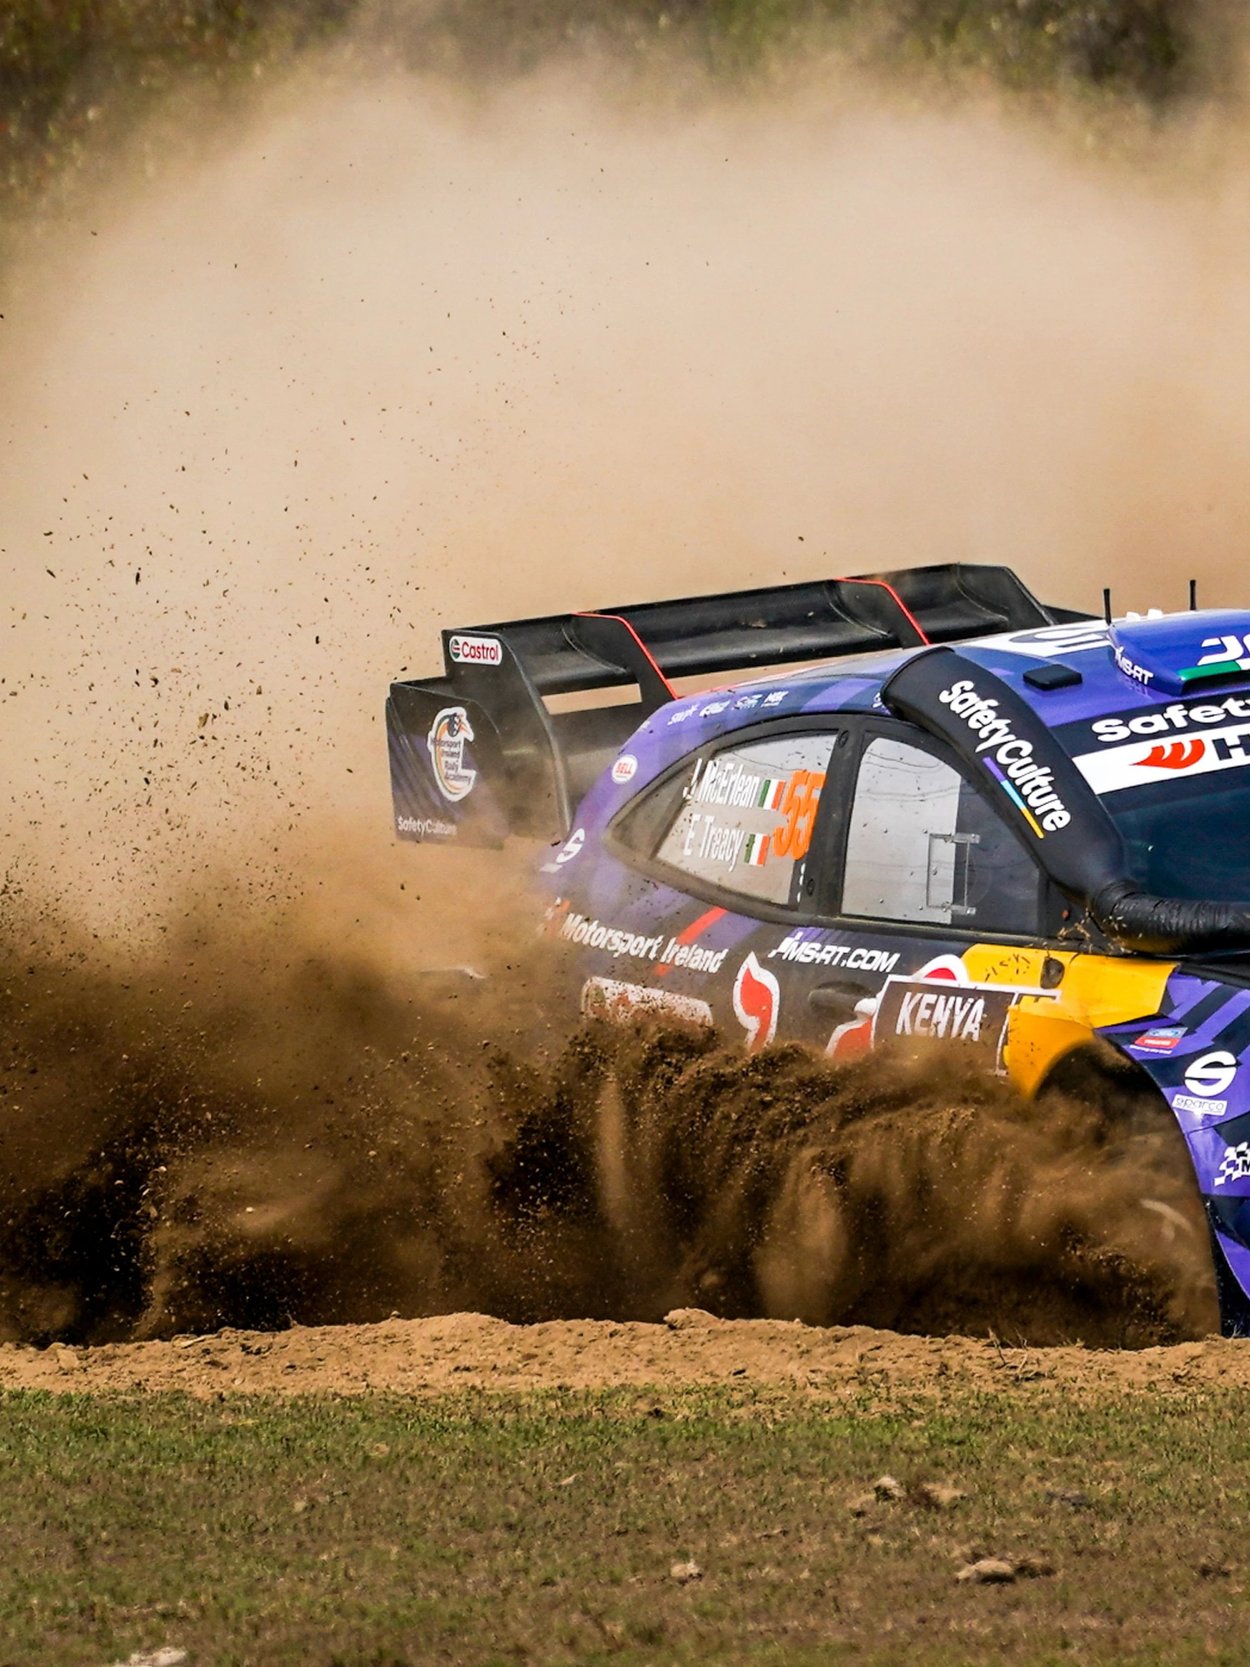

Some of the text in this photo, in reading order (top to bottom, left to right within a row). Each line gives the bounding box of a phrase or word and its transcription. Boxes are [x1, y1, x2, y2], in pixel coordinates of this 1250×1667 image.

[461, 641, 499, 661] Castrol
[682, 758, 761, 809] J McErlean
[939, 681, 1071, 831] SafetyCulture
[397, 815, 457, 837] SafetyC
[772, 769, 827, 861] 55
[682, 813, 746, 873] E Treacy
[561, 913, 729, 973] Motorsport Ireland
[896, 991, 985, 1042] KENYA
